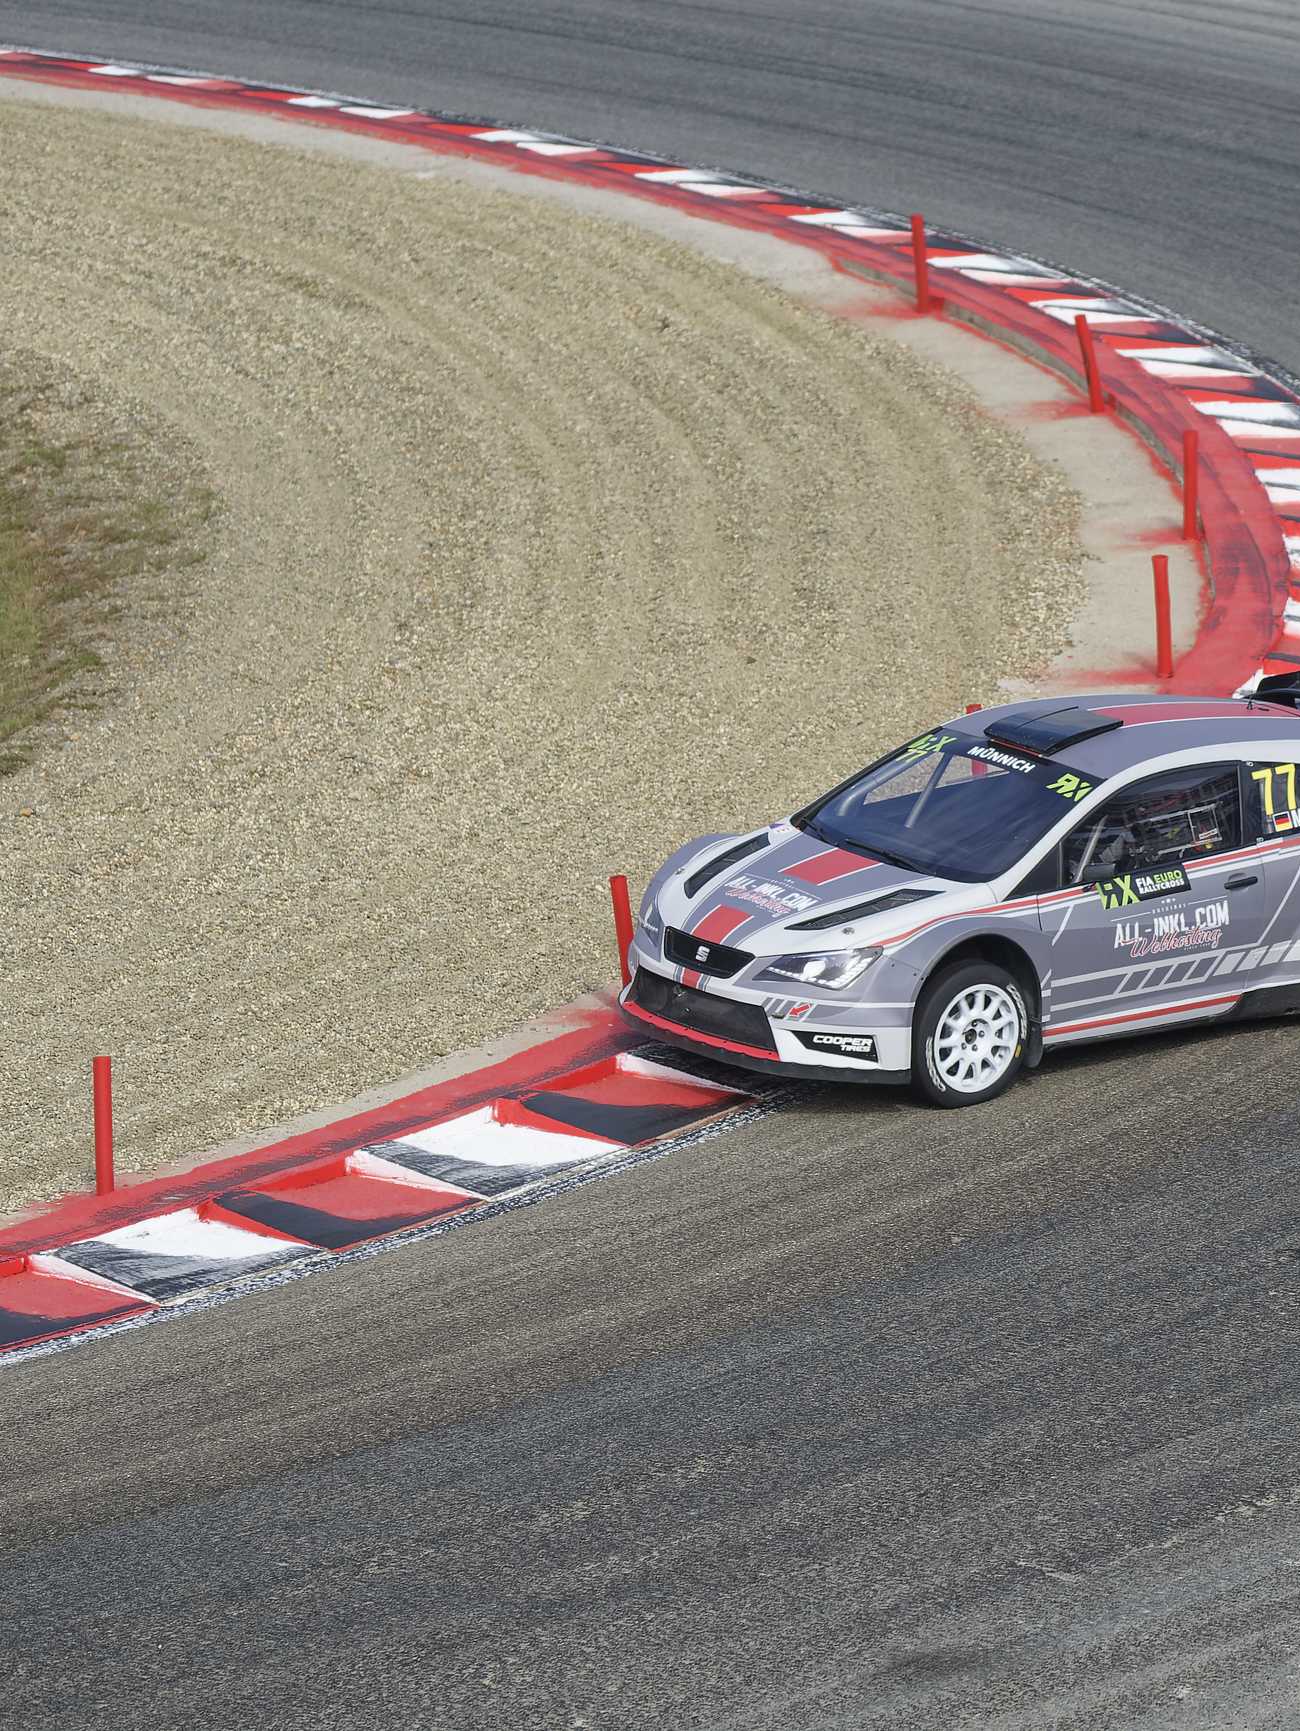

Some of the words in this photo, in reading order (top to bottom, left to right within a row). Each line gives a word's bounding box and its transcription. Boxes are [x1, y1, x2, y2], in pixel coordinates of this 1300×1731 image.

[967, 746, 1035, 773] MÜNNICH
[1251, 763, 1296, 816] 77
[1136, 876, 1154, 889] FIA
[1153, 869, 1182, 884] EURO
[1138, 879, 1185, 895] RALLYCROSS
[1114, 900, 1230, 949] ALL-INKL.COM
[813, 1035, 873, 1047] COOPER
[841, 1045, 871, 1053] TIRES
